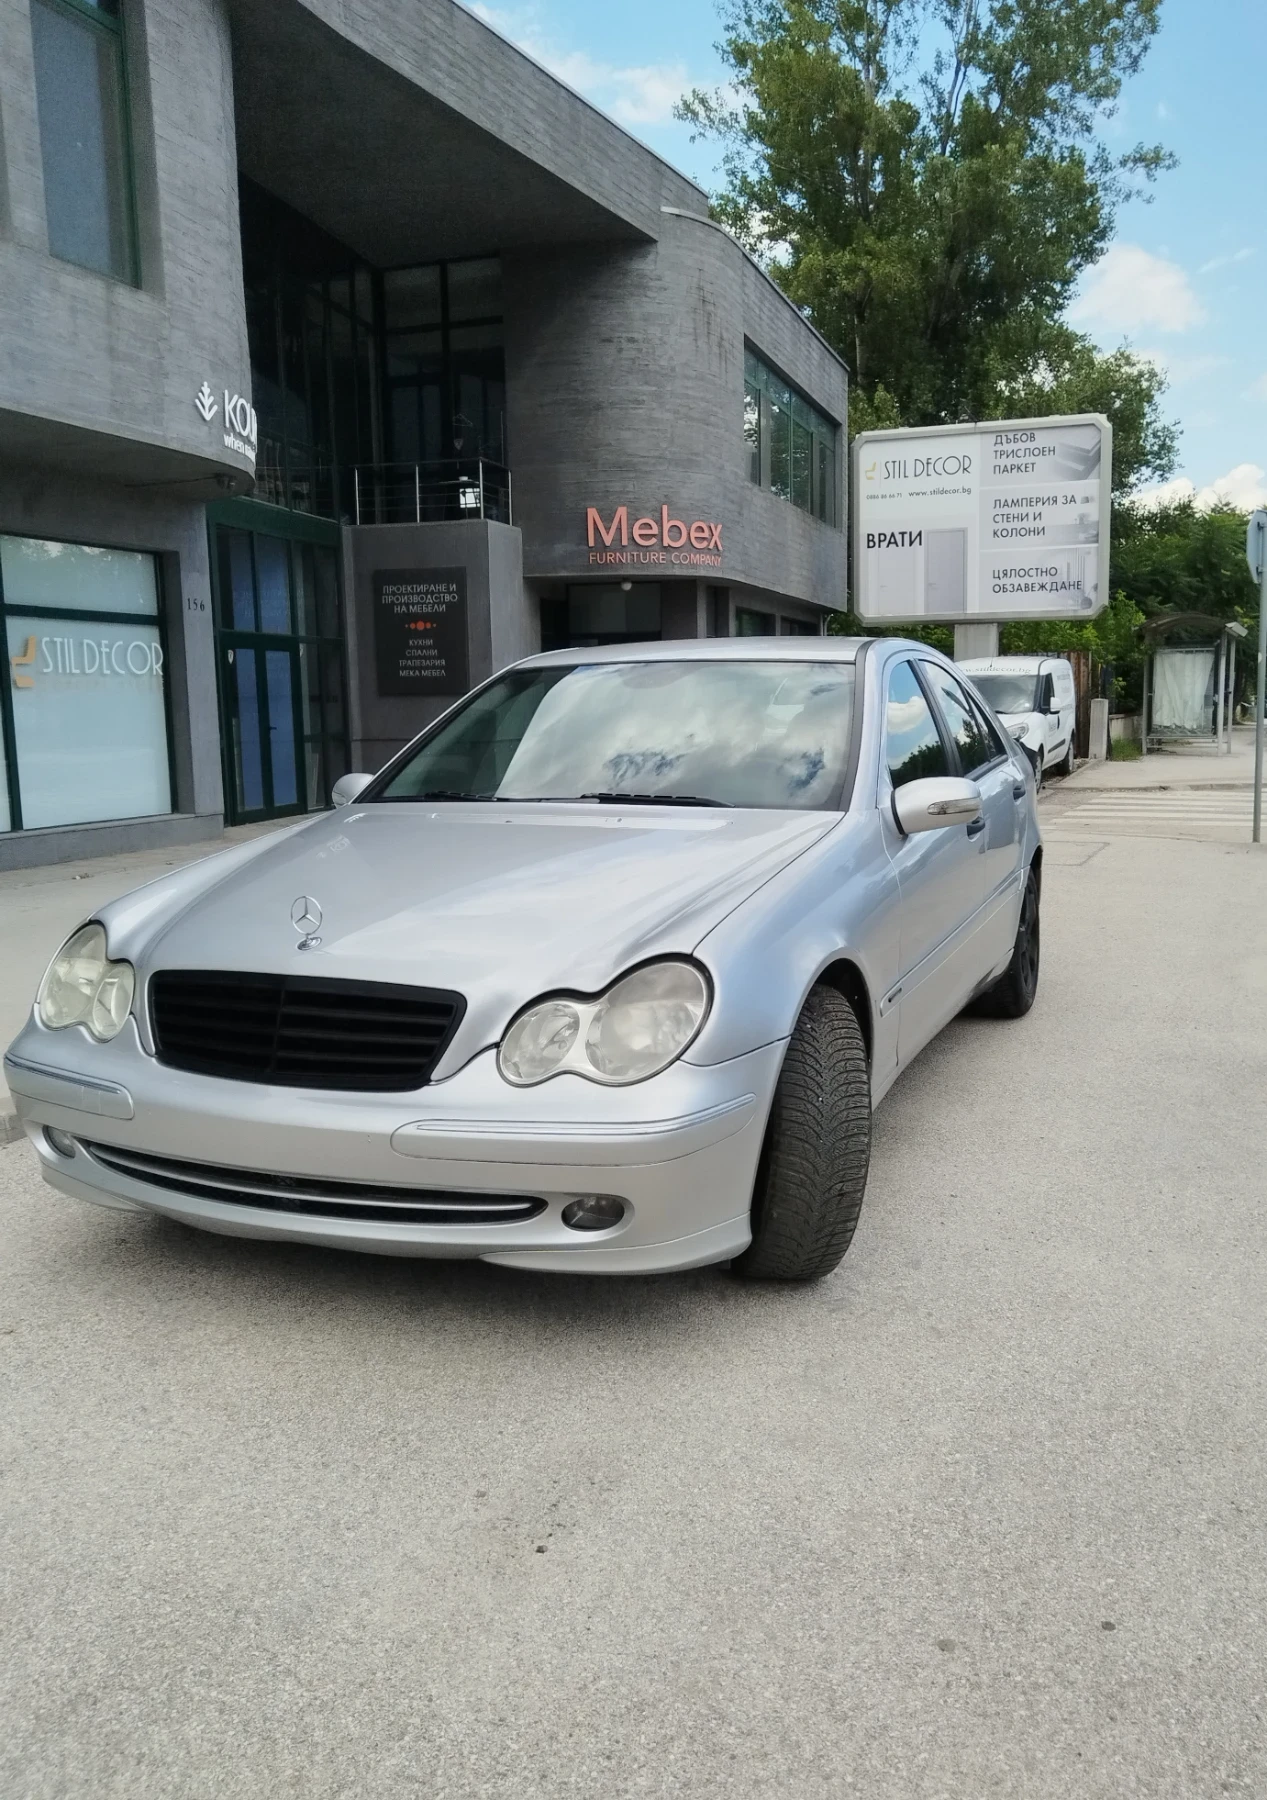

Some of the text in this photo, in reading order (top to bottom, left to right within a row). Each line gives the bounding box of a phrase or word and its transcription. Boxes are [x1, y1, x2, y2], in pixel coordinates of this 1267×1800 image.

[993, 432, 1036, 447] ДЪБОВ
[993, 445, 1056, 460] ТРИСЛОЕН
[883, 455, 972, 480] STIL DECOR
[993, 462, 1036, 475] ПАРКЕТ
[908, 486, 972, 498] www.stildecor.bg
[993, 494, 1077, 509] ЛАМПЕРИЯ ЗА
[992, 511, 1042, 524] СТЕНИ И
[586, 504, 723, 551] Mebex
[992, 526, 1046, 539] КОЛОНИ
[866, 530, 923, 549] ВРАТИ
[589, 551, 722, 567] FURNITURE COMPANY
[992, 566, 1058, 580] ЦЯЛОСТНО
[382, 583, 457, 594] ПРОЕКТИРАНЕ И
[992, 580, 1083, 594] ОБЗАВЕЖДАНЕ
[187, 597, 205, 612] 156
[382, 593, 458, 604] ПРОИЗВОДСТВО
[394, 603, 446, 613] НА МЕБЕЛИ
[399, 659, 446, 667] ТРАПЕЗАРИЯ
[399, 669, 446, 677] МЕКА МЕБЕЛ
